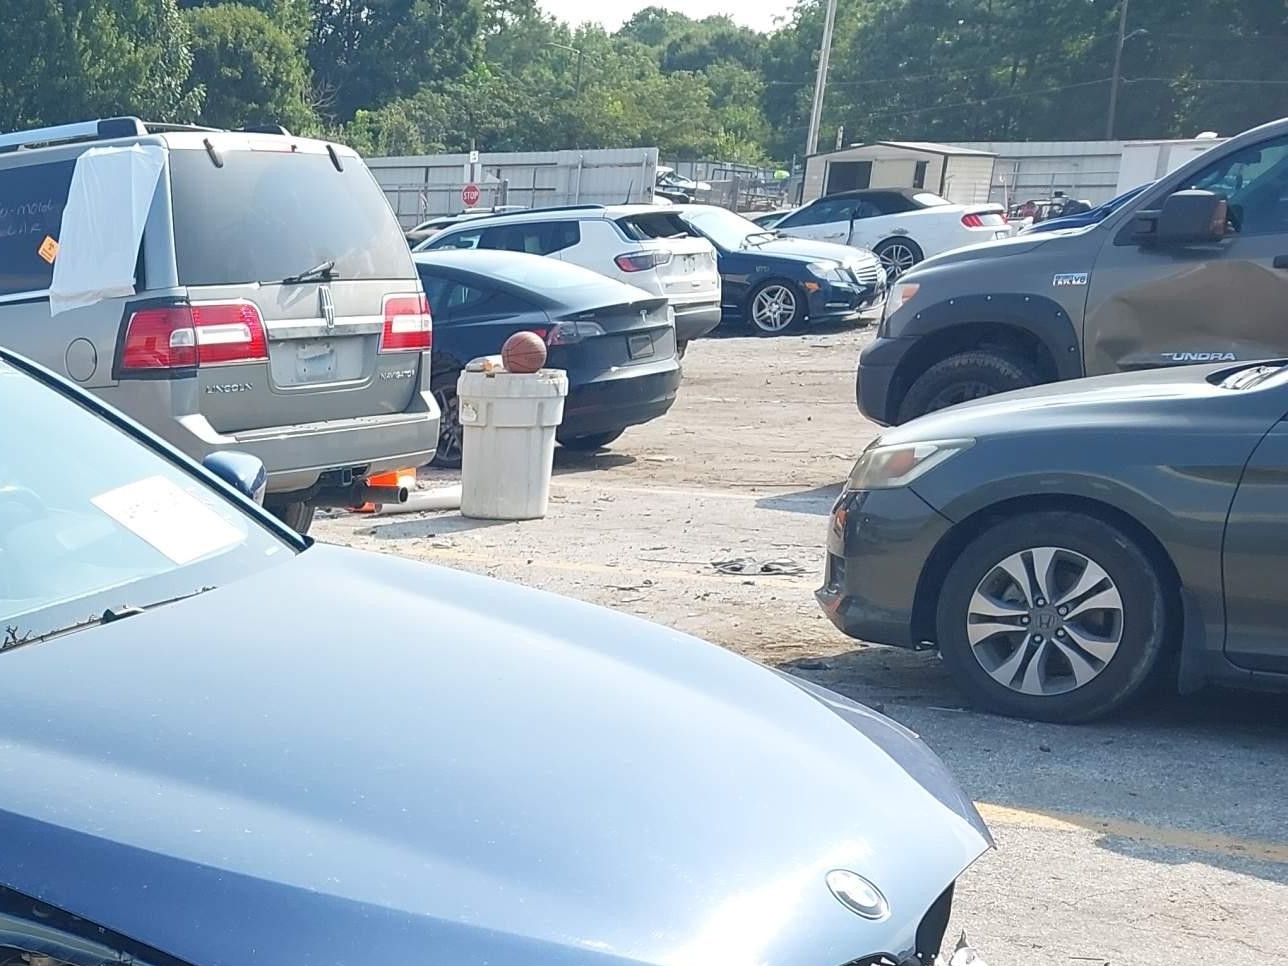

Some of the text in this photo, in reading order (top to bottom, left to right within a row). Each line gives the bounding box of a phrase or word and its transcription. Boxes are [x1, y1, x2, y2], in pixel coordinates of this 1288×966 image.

[463, 191, 479, 200] STOP
[1161, 353, 1236, 361] TUNDRA
[205, 383, 253, 394] LINCOLN
